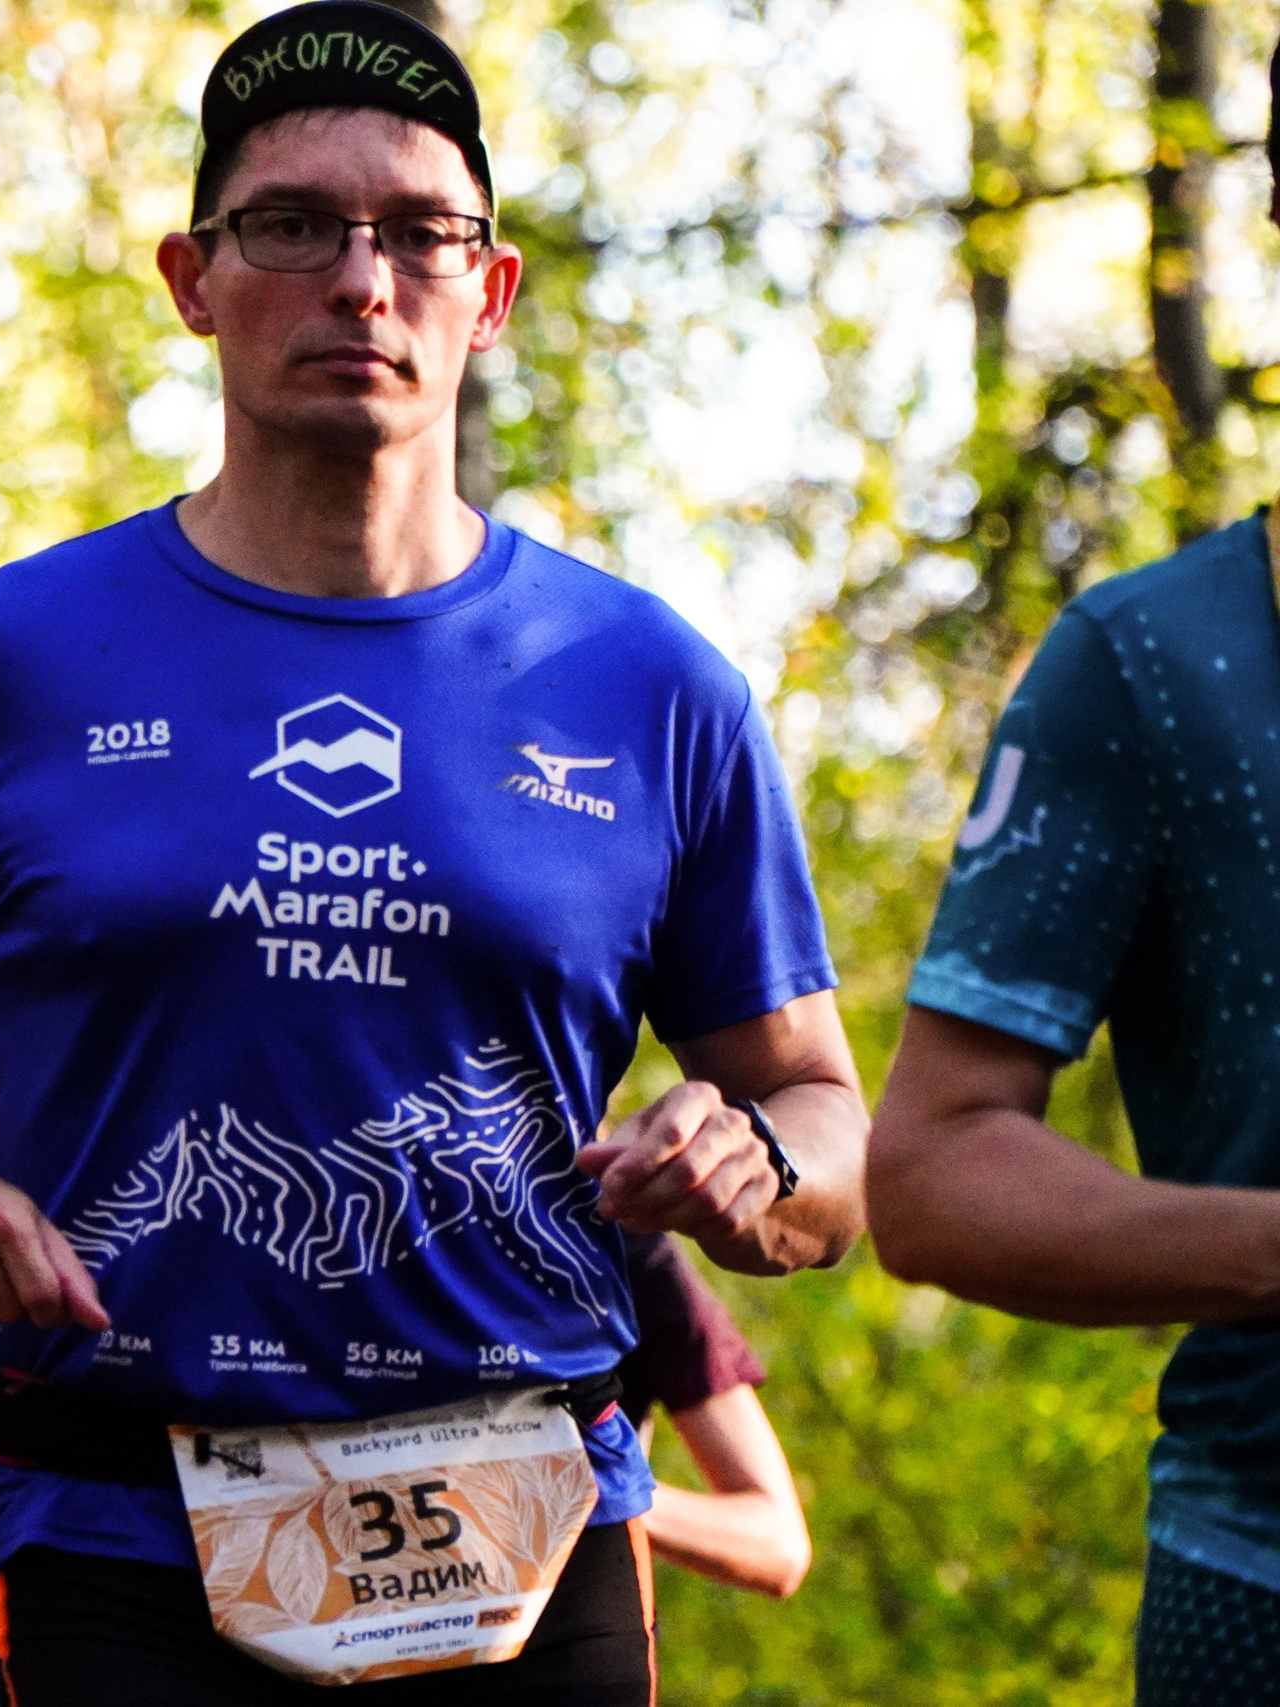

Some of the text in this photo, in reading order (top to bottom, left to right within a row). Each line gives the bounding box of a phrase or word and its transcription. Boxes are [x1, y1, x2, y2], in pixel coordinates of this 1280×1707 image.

[87, 719, 170, 752] 2018
[210, 877, 450, 937] Marafon
[257, 938, 407, 987] TRAIL
[210, 1334, 241, 1356] 35
[346, 1341, 379, 1363] 56
[478, 1344, 520, 1365] 106
[341, 1420, 541, 1456] Backyard Ultra Moscow
[349, 1480, 462, 1563] 35
[348, 1560, 488, 1606] Вадим
